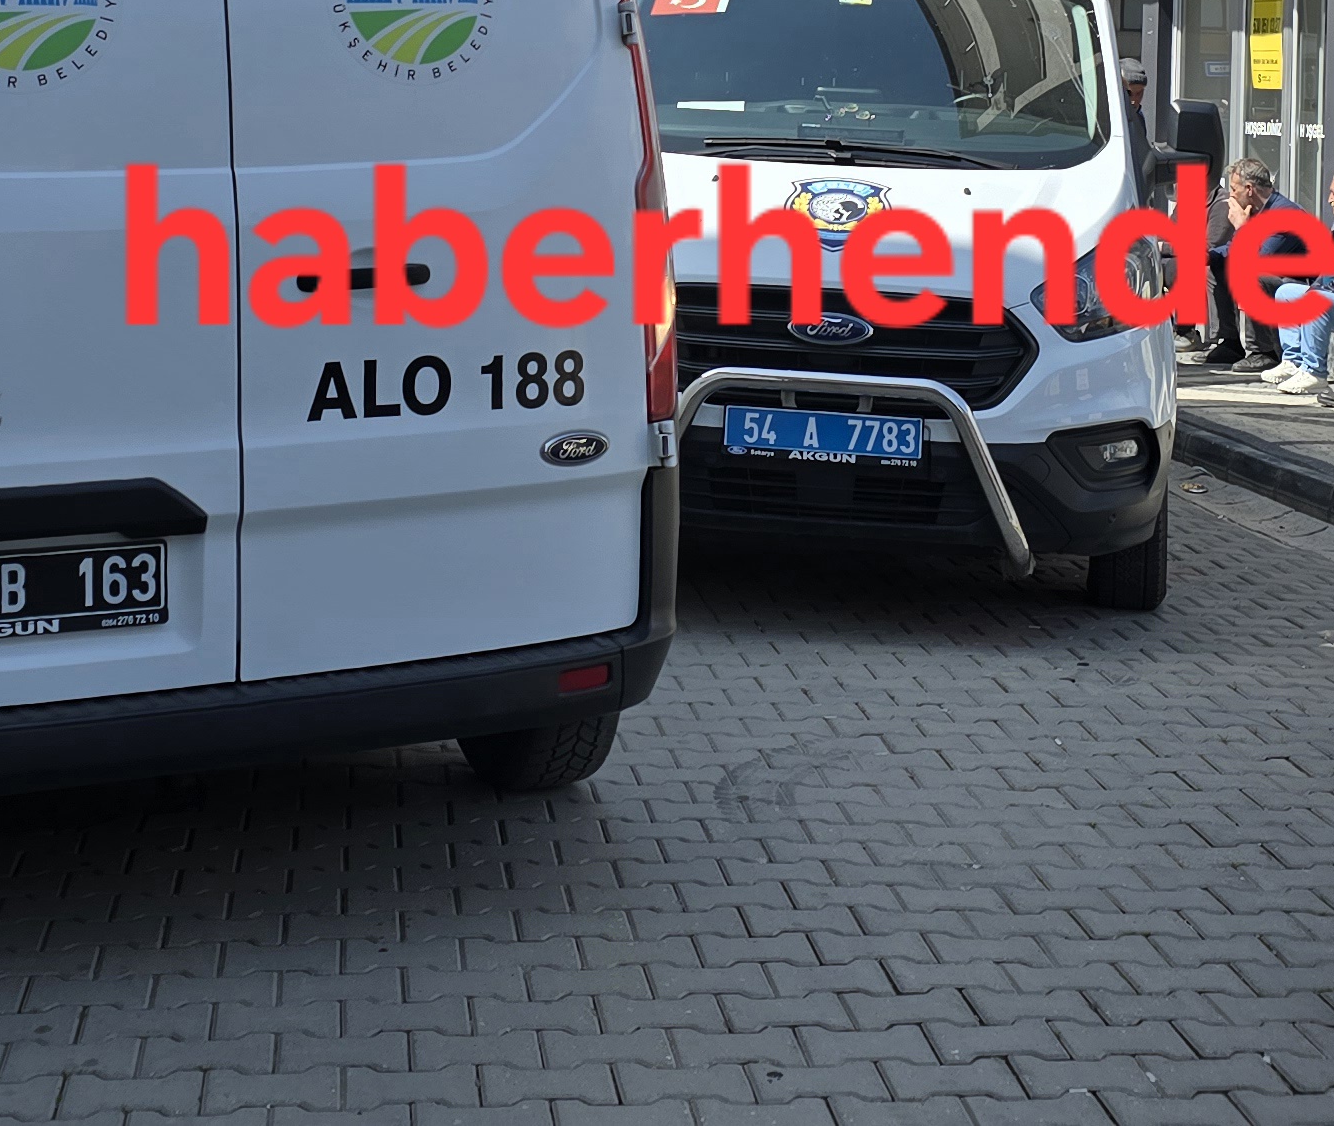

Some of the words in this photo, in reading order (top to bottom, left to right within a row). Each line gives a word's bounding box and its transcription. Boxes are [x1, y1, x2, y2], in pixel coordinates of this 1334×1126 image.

[307, 355, 452, 422] ALO
[480, 349, 585, 410] 188
[743, 412, 777, 445] 54
[803, 416, 819, 448] A
[847, 418, 916, 454] 7783
[78, 552, 157, 608] 163
[117, 615, 134, 626] 276
[135, 614, 146, 624] 72
[147, 612, 159, 624] 10
